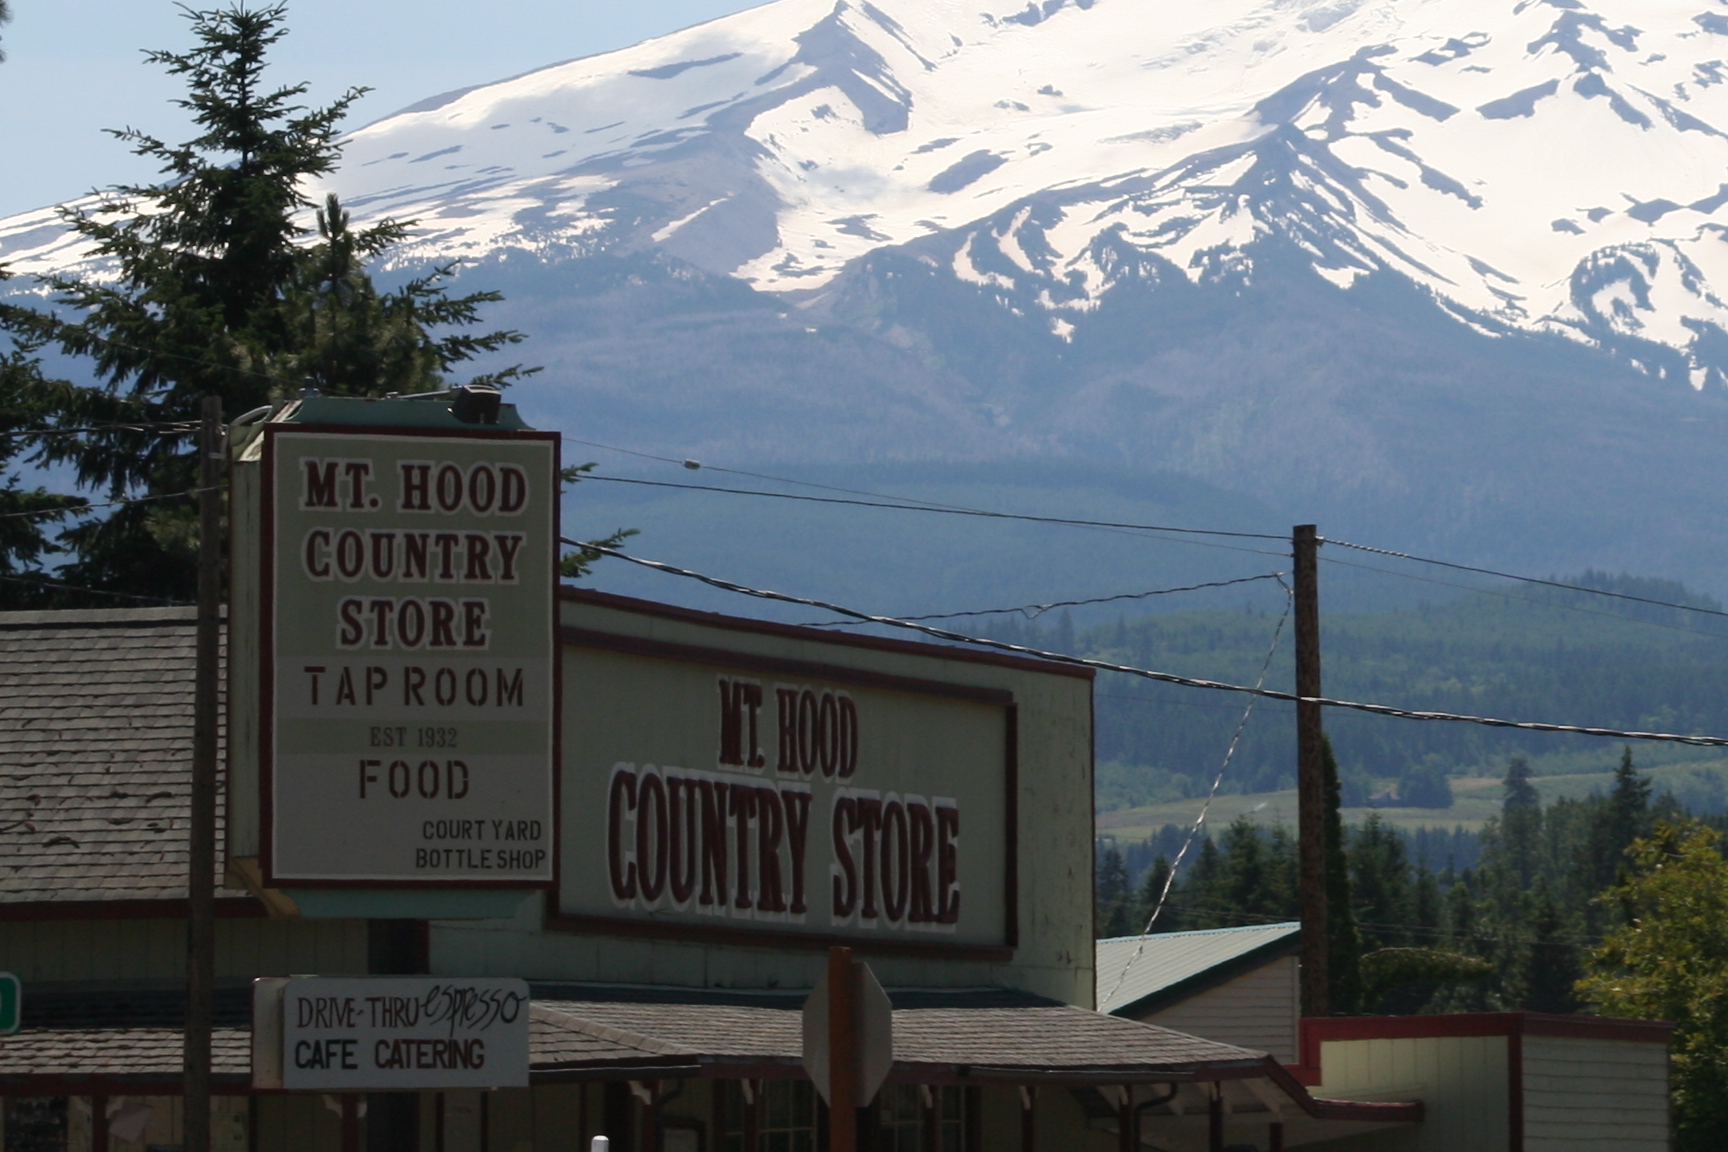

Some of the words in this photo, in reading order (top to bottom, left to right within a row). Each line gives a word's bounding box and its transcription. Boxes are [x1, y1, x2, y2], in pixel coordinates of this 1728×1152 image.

[304, 460, 379, 509] MT.
[401, 463, 526, 512] HOOD
[305, 529, 523, 580] COUNTRY
[339, 599, 488, 647] STORE
[370, 726, 407, 747] EST
[417, 727, 458, 748] 1932
[718, 679, 766, 769] MT.
[775, 687, 858, 779] HOOD
[359, 759, 470, 800] FOOD
[422, 820, 486, 840] COURT
[491, 820, 542, 841] YARD
[608, 768, 813, 915] COUNTRY
[831, 795, 961, 924] STORE
[421, 984, 528, 1038] espresso
[294, 1038, 358, 1070] CAFE
[374, 1038, 485, 1070] CATERING
